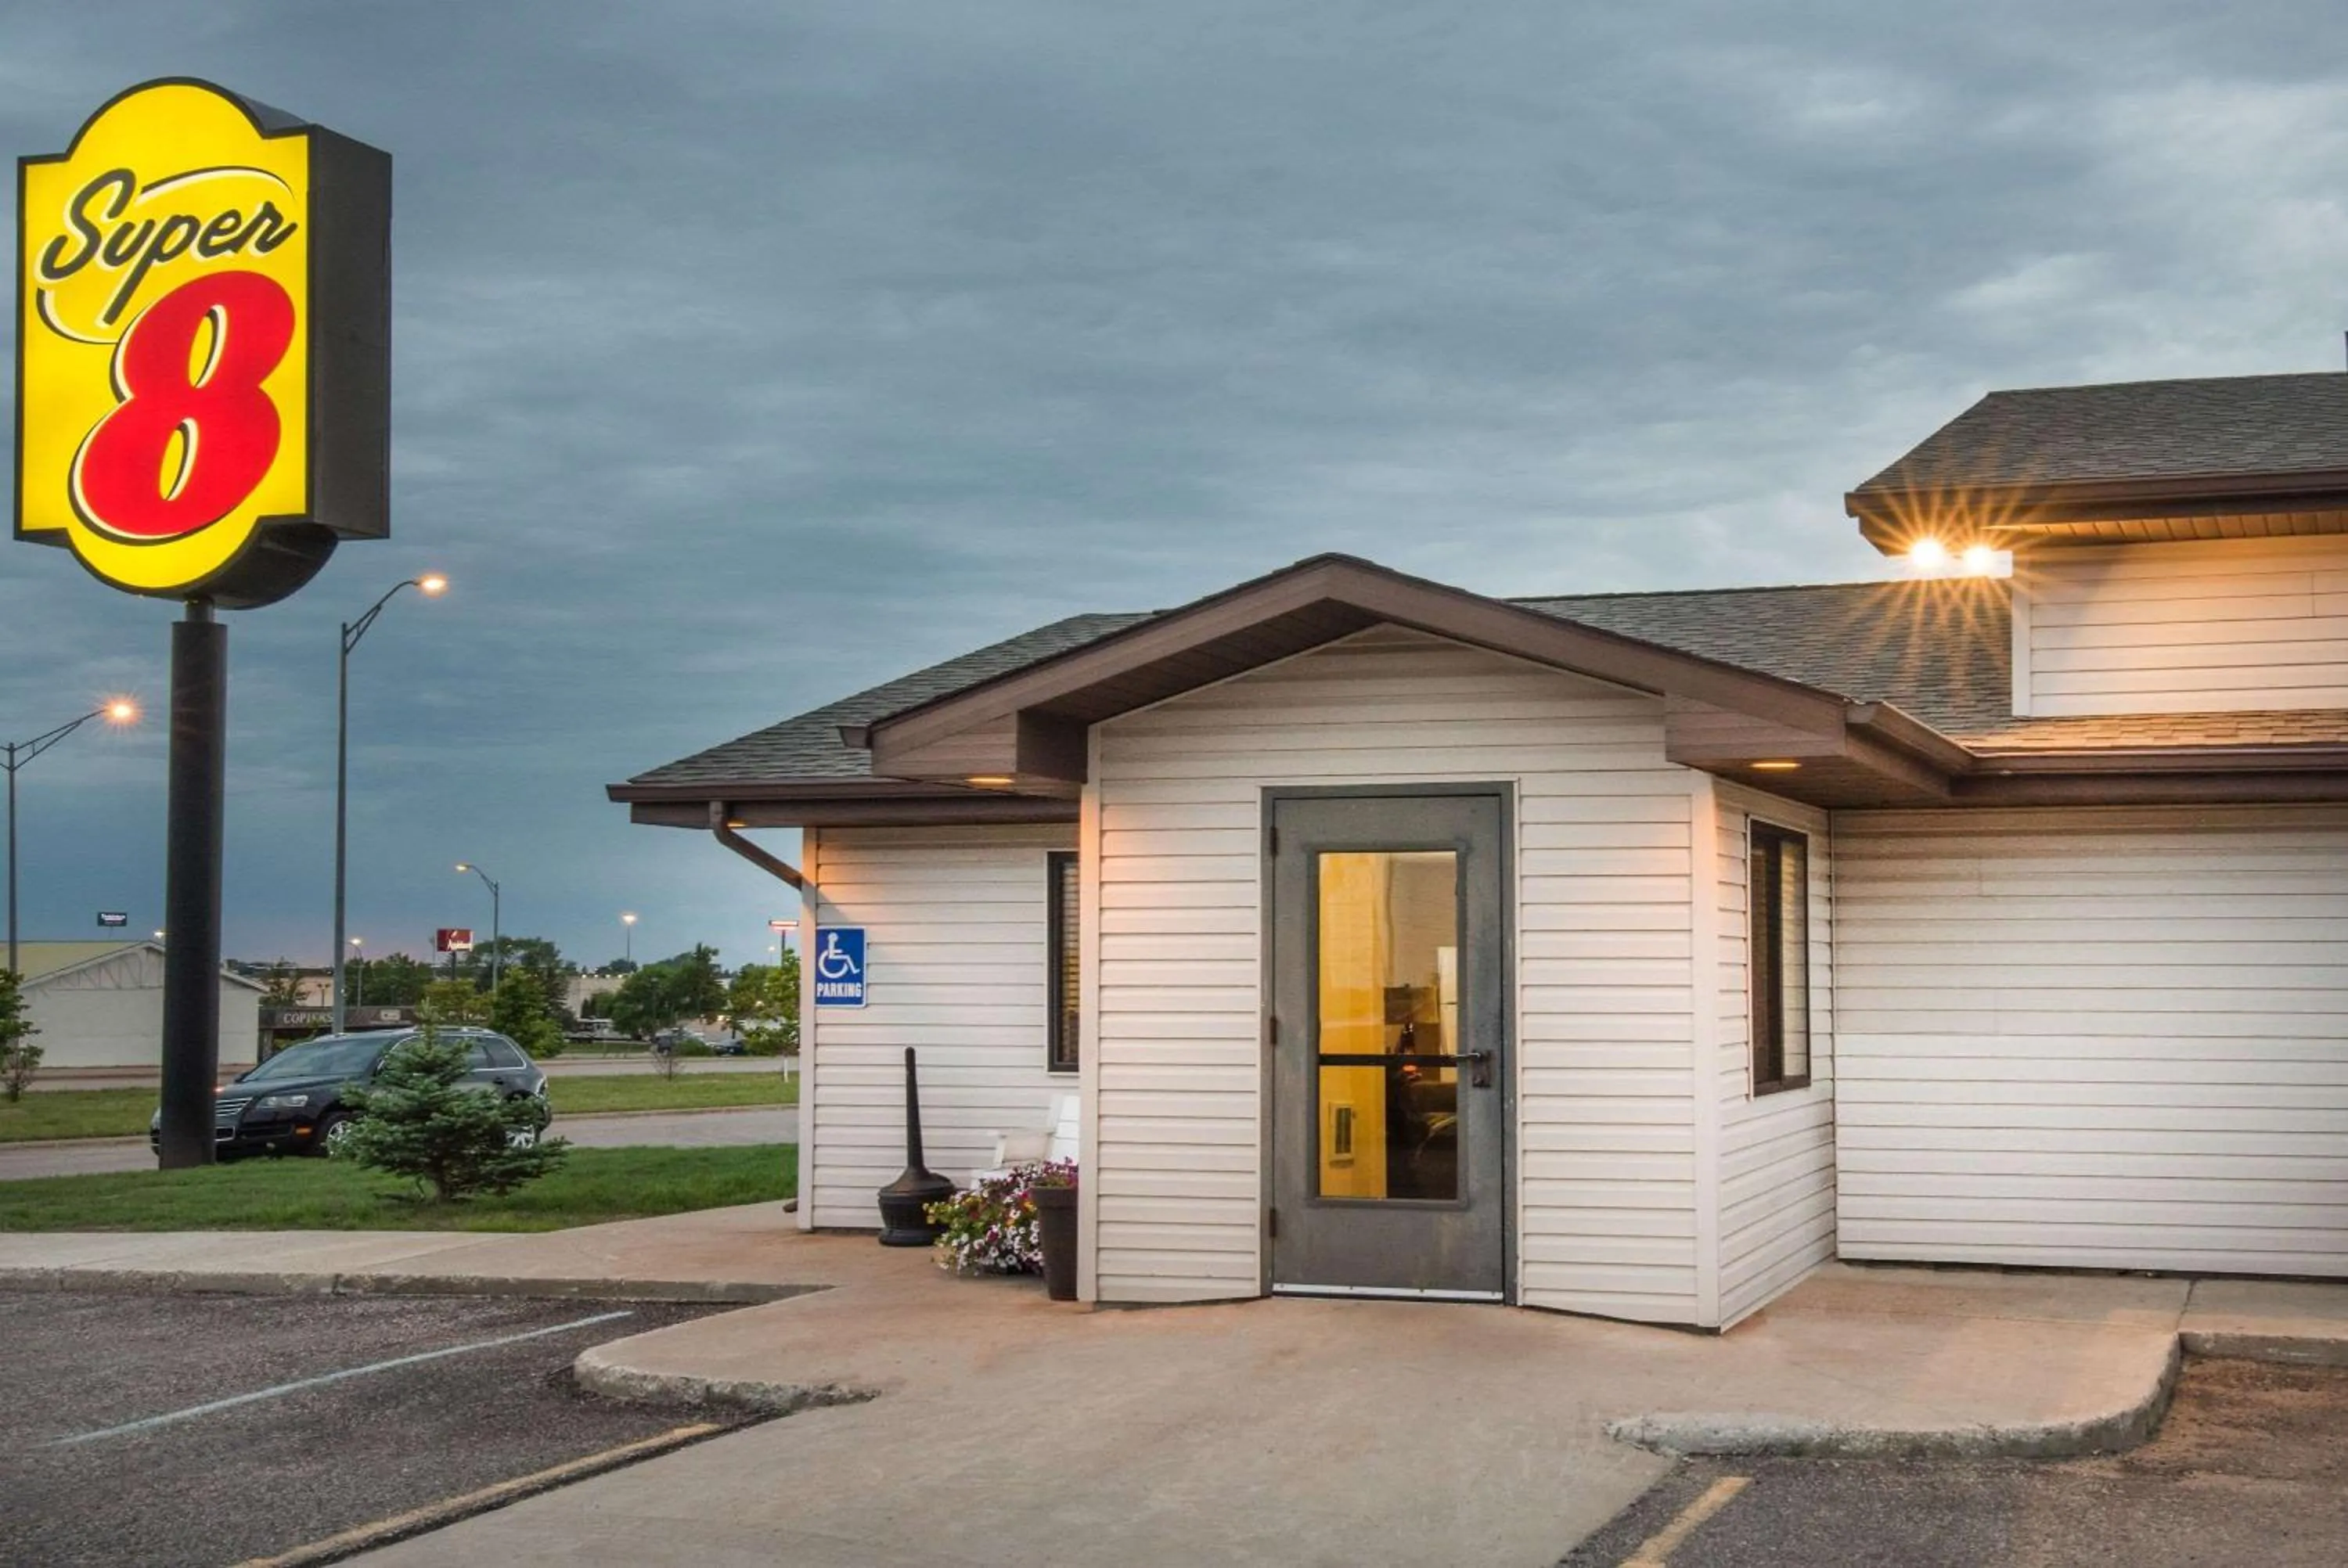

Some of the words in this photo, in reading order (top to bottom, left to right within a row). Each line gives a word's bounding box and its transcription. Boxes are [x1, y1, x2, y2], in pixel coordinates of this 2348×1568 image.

[39, 167, 298, 329] Super
[69, 270, 296, 545] 8
[816, 982, 862, 998] PARKING
